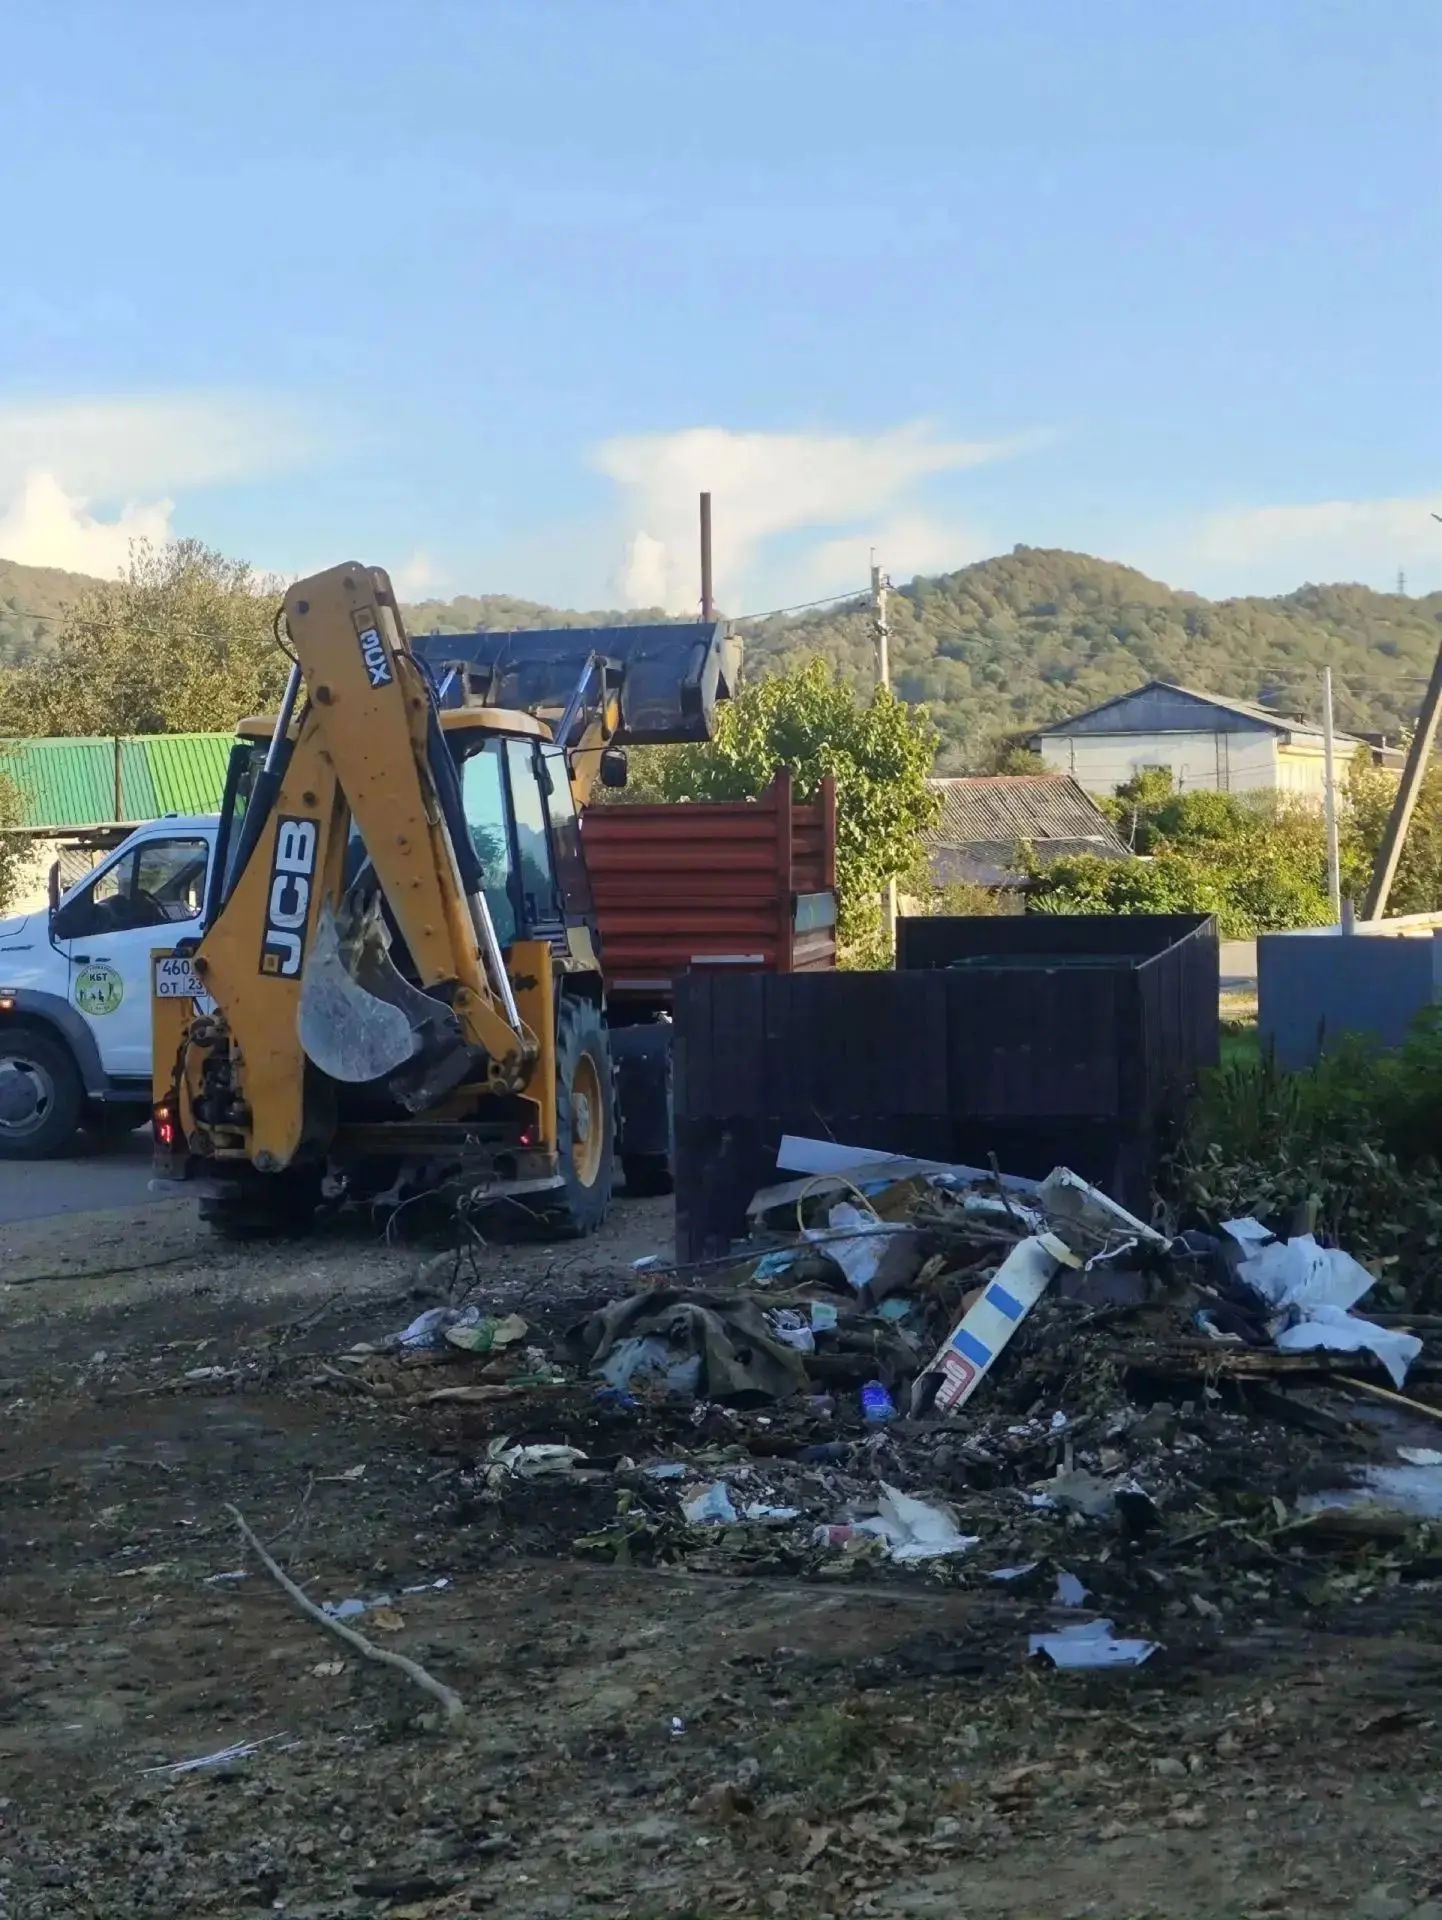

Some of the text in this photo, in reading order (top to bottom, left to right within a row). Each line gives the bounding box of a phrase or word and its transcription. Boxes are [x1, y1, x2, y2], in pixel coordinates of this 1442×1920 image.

[360, 629, 391, 686] 3CX
[266, 820, 316, 975] JCB
[162, 960, 192, 975] 460
[188, 978, 203, 990] 23
